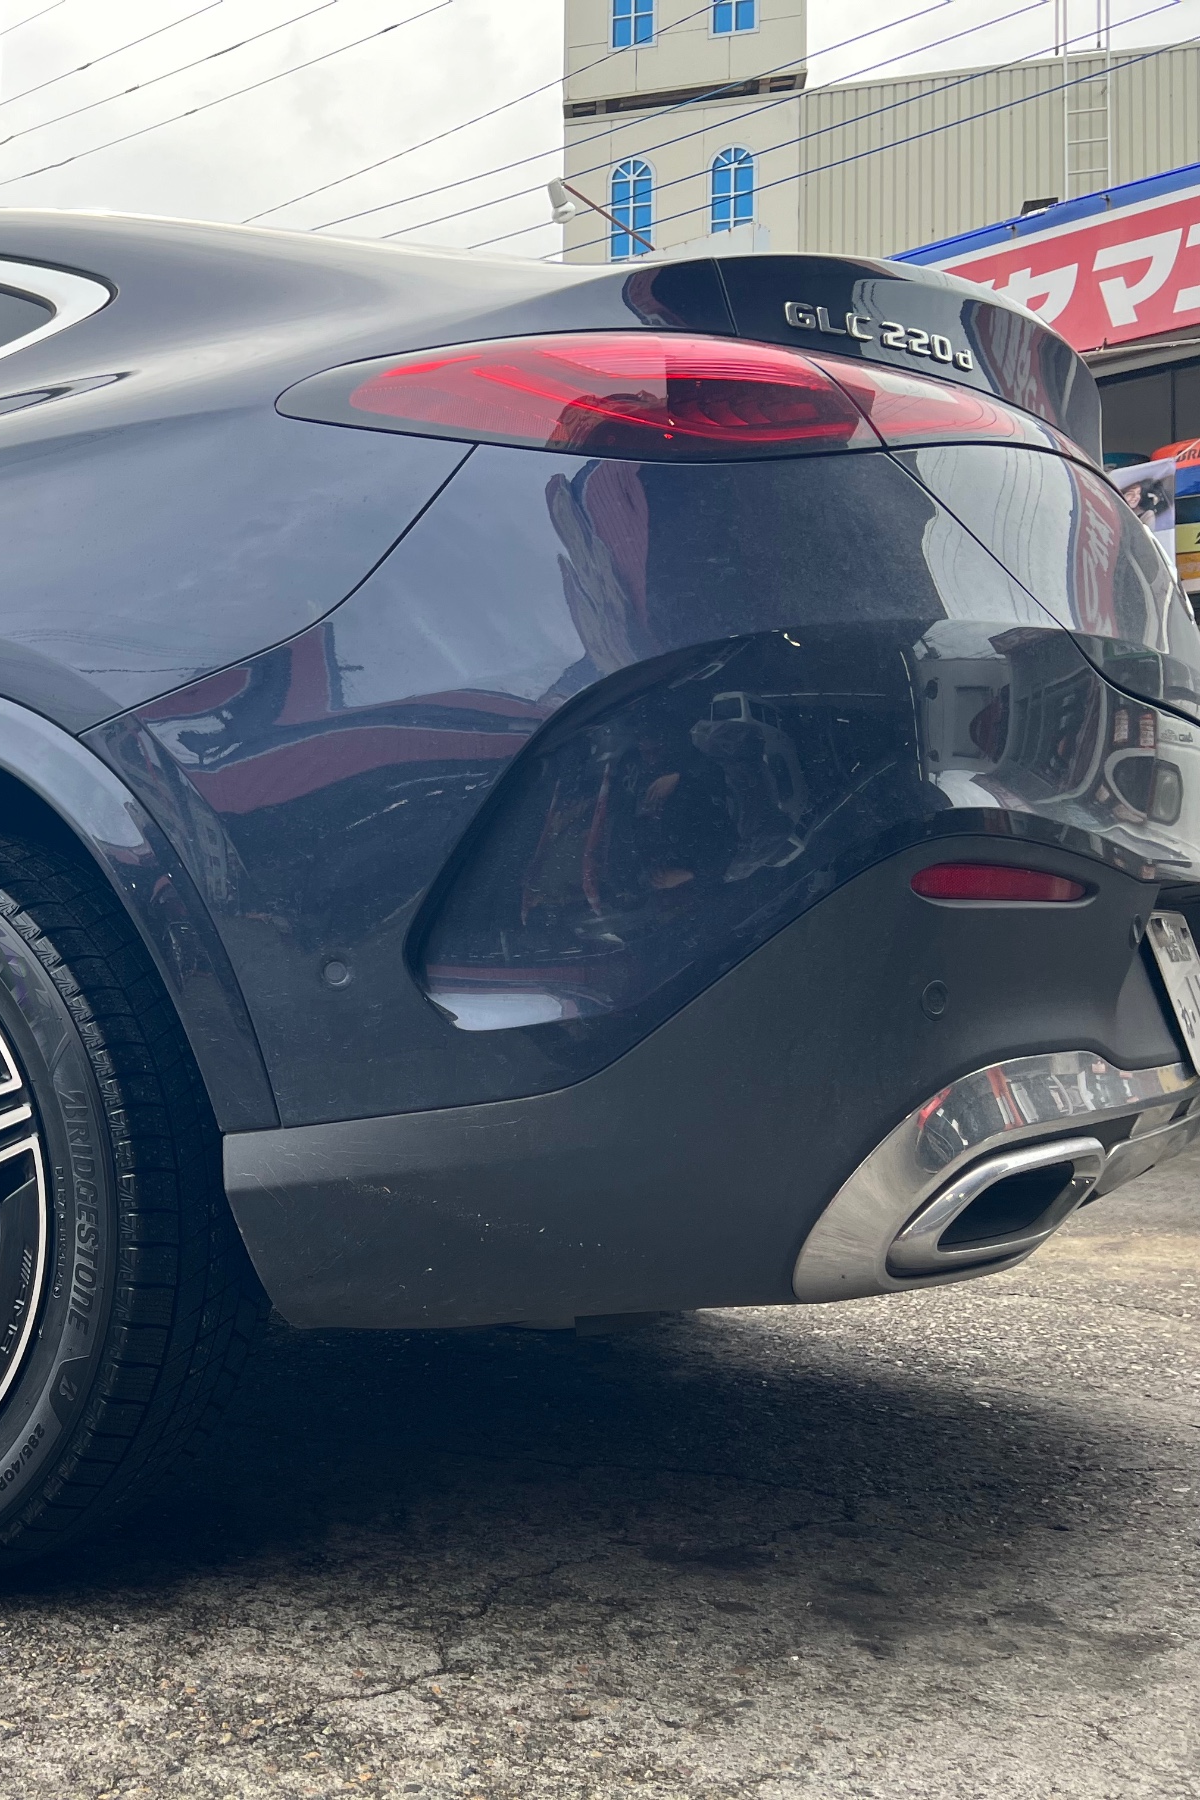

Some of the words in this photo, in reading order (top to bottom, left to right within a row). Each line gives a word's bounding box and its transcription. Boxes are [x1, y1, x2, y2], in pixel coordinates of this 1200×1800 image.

[980, 222, 1200, 328] ヤマ
[784, 301, 874, 341] GLC
[879, 321, 953, 363] 220
[952, 348, 974, 372] d
[58, 1090, 99, 1336] BRIDGESTONE
